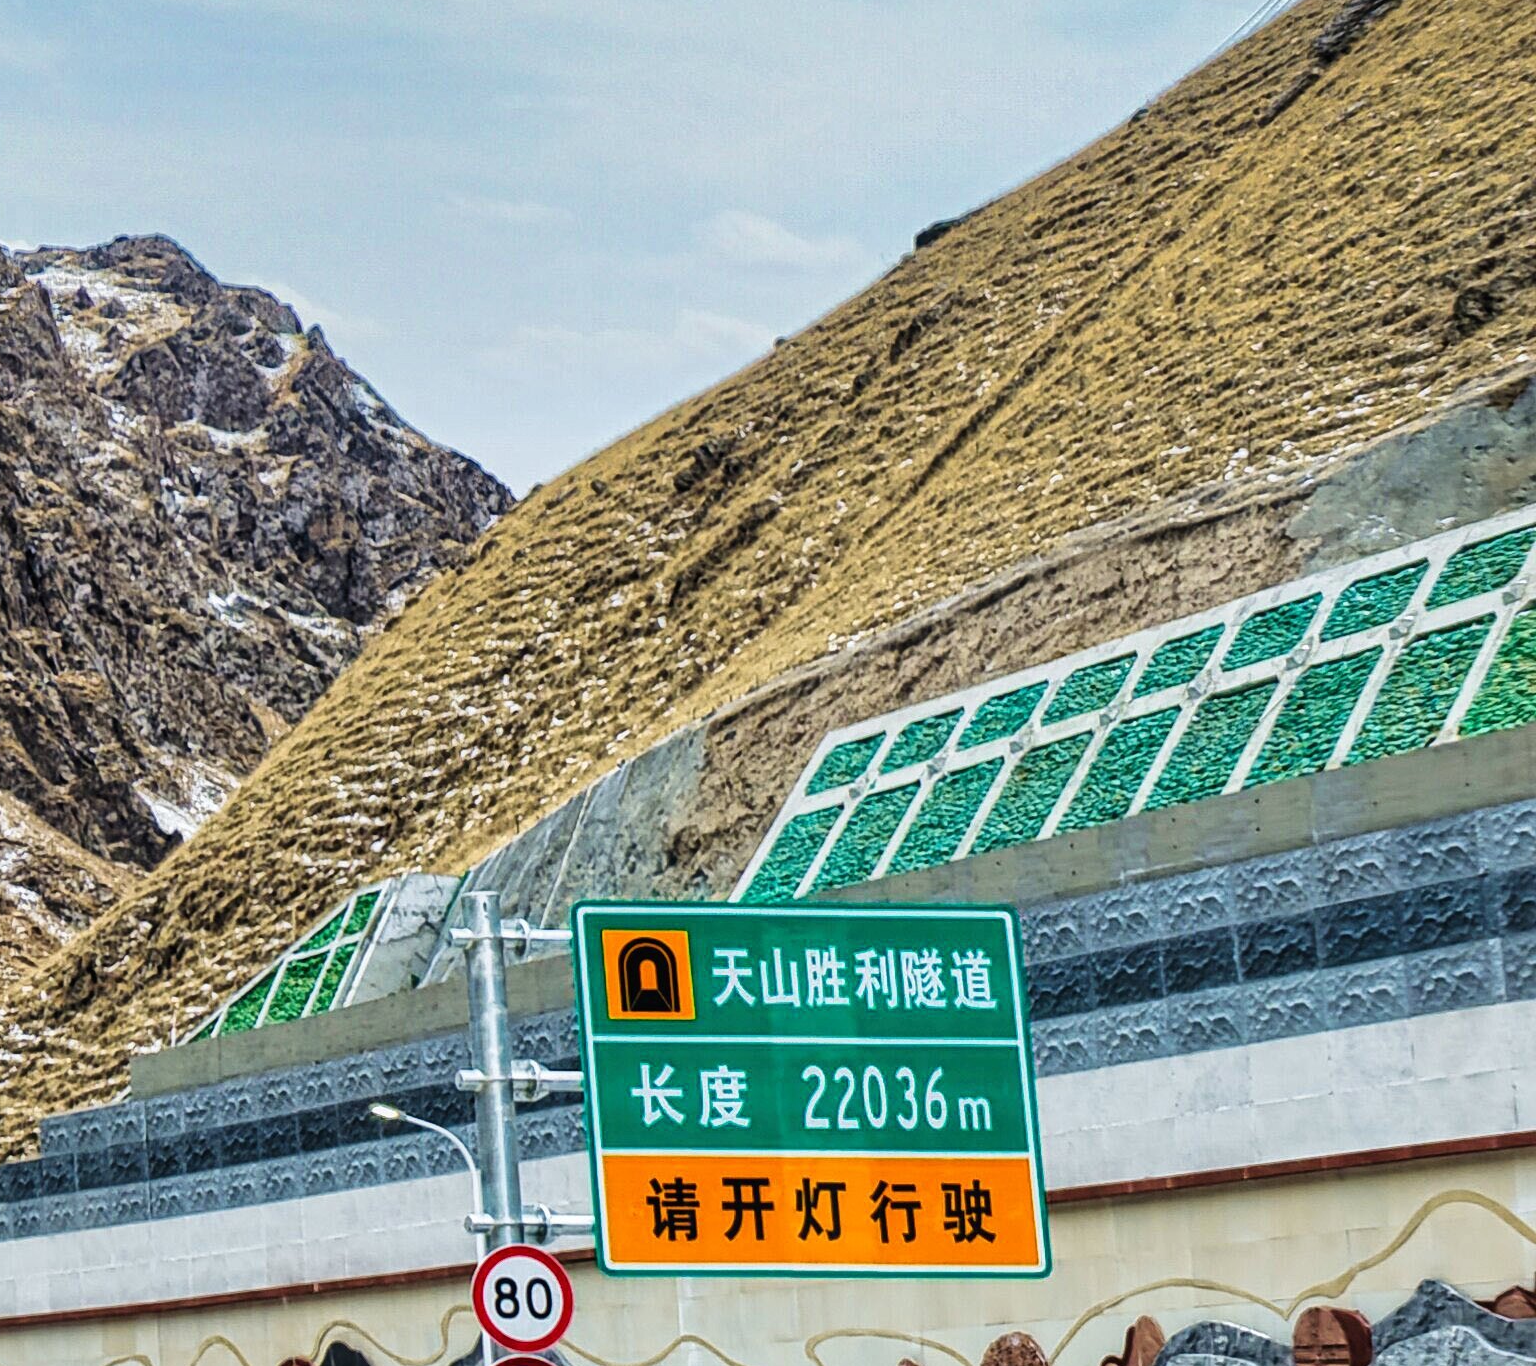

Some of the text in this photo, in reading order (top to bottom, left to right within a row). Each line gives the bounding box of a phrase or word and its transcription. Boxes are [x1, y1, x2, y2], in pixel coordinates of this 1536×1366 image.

[712, 947, 998, 1009] 天山胜利隧道
[631, 1062, 993, 1131] 长度 22036m
[646, 1177, 998, 1244] 请开灯行驶
[494, 1277, 553, 1320] 80
